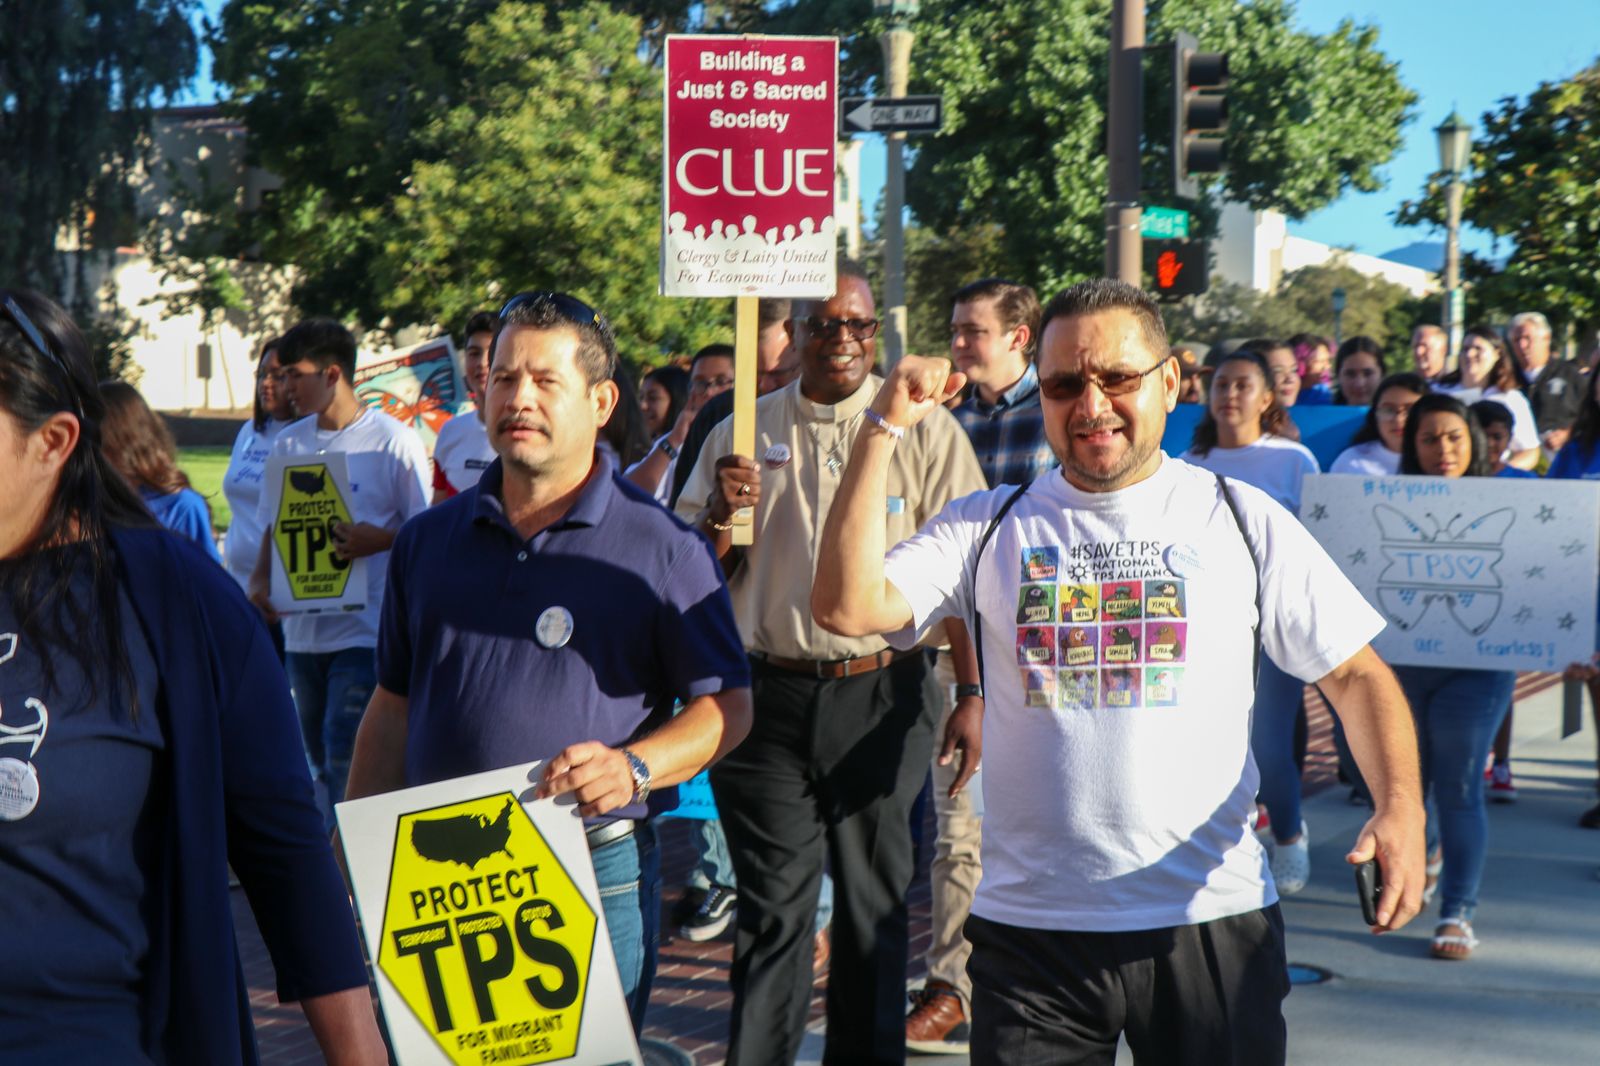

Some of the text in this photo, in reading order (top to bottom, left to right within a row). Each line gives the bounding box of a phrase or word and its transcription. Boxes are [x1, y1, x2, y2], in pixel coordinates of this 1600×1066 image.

[700, 51, 805, 75] Building a
[677, 80, 827, 100] Just & Sacred
[709, 109, 790, 133] Society
[870, 106, 932, 123] ONE WAY
[675, 148, 829, 197] CLUE
[676, 249, 828, 267] Clergy & Laity United
[677, 269, 827, 286] For Economic Justice
[289, 500, 337, 517] PROTECT
[1093, 558, 1158, 571] NATIONAL
[1093, 568, 1173, 582] TPS ALLIANC
[1395, 552, 1457, 580] TPS
[410, 865, 540, 919] PROTECT
[392, 899, 579, 1032] TPS
[457, 1014, 563, 1052] FOR MIGRANT
[480, 1036, 552, 1066] FAMILIES
